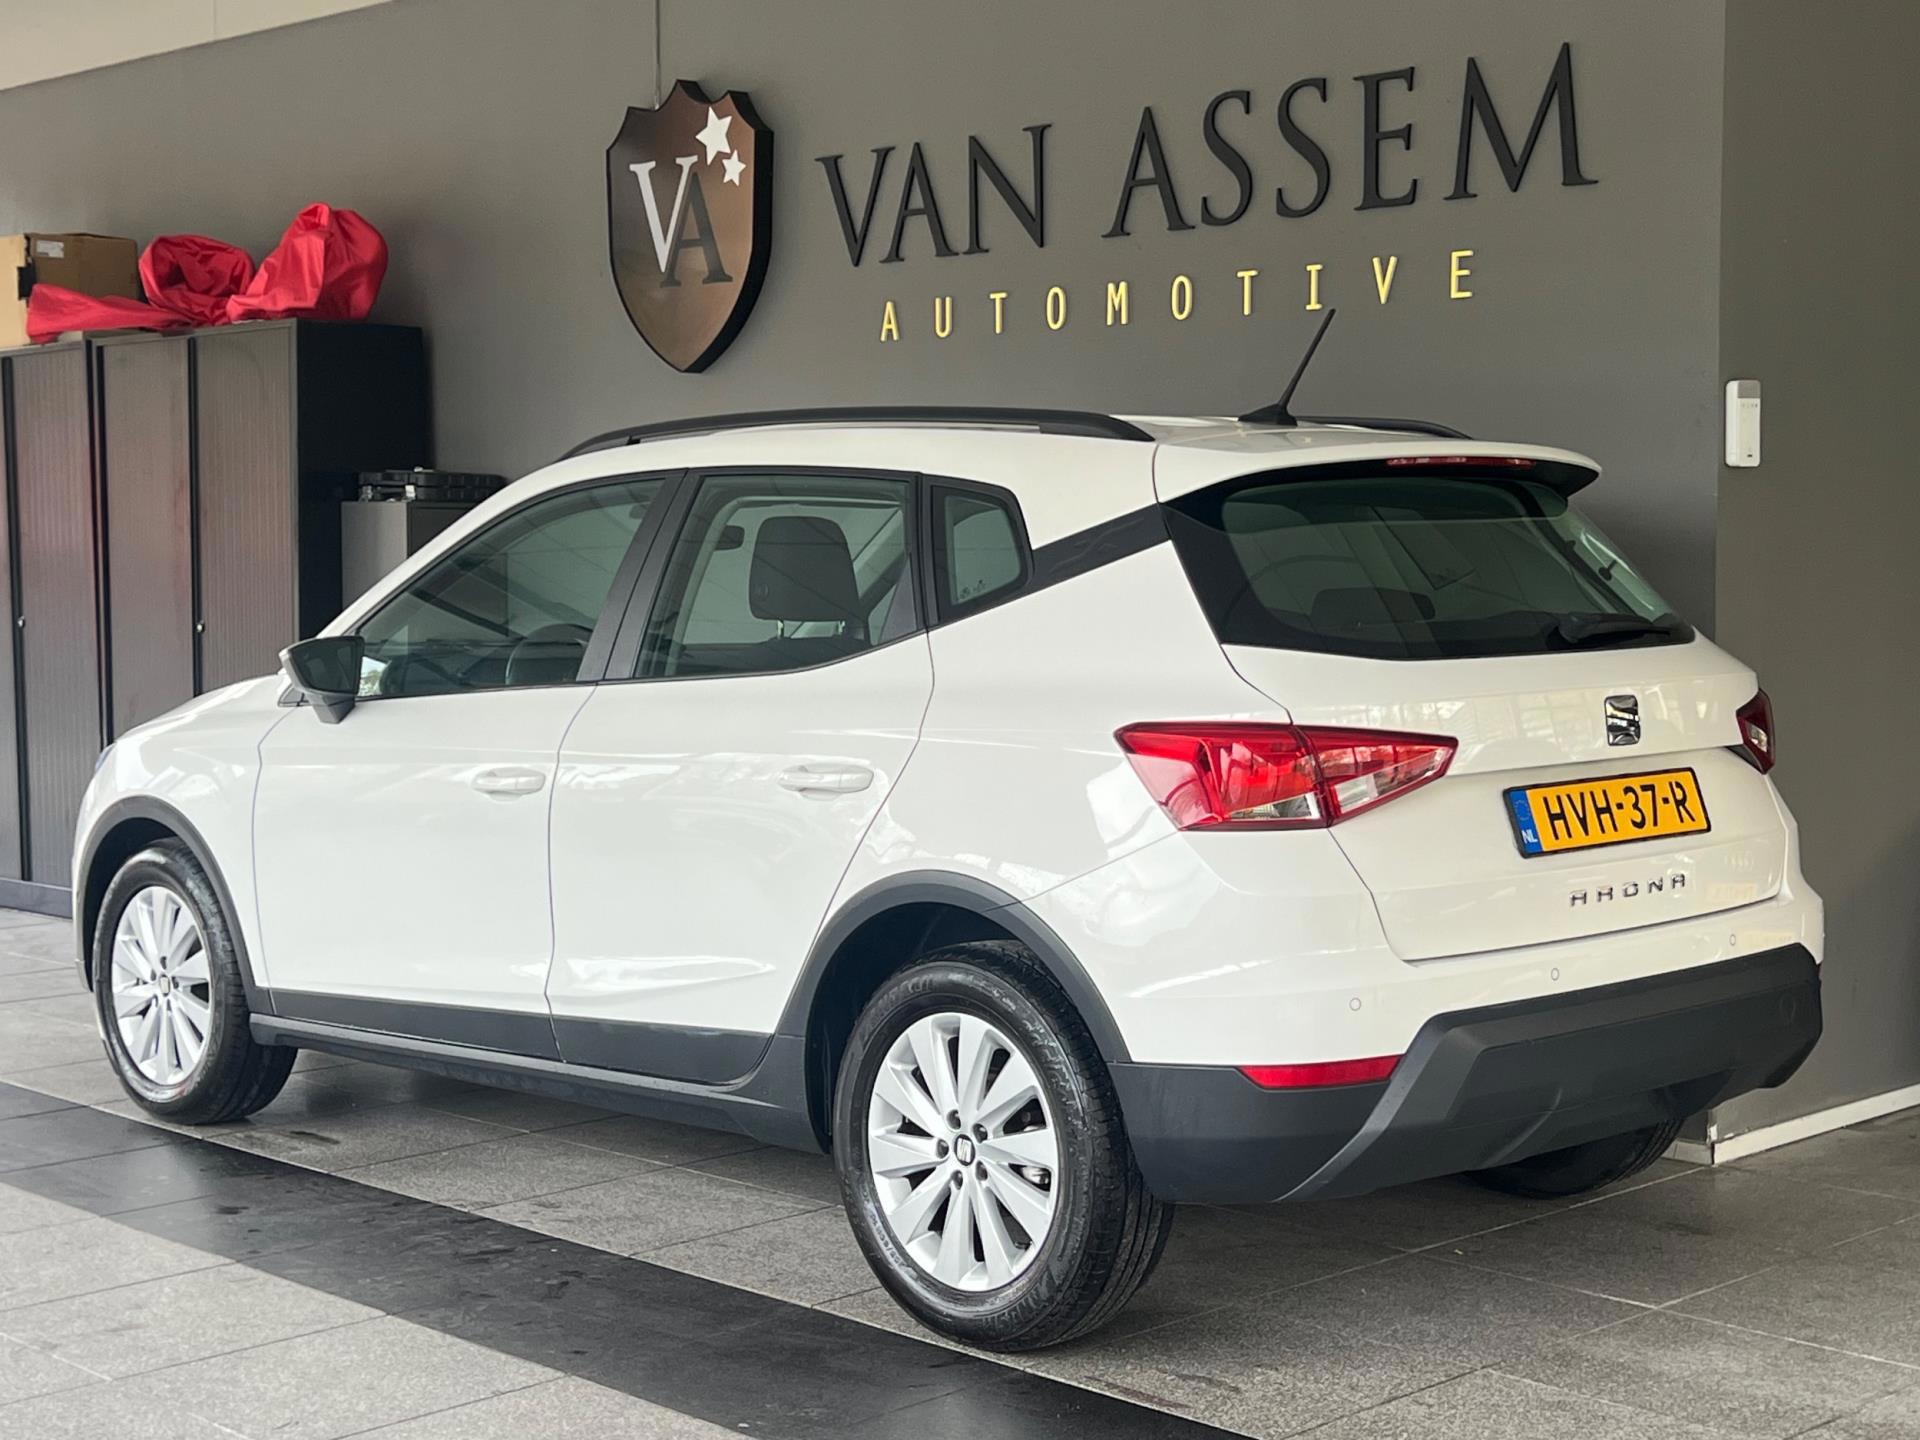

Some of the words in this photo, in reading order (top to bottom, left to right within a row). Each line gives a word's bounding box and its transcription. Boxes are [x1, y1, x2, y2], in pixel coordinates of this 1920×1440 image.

[813, 123, 1053, 267] VAN
[1101, 41, 1599, 238] ASSEM
[629, 154, 733, 288] VA
[880, 249, 1474, 342] AUTOMOTIVE
[1521, 829, 1538, 844] NL
[1543, 780, 1696, 841] HVH-37-R
[1569, 873, 1685, 906] ARONA
